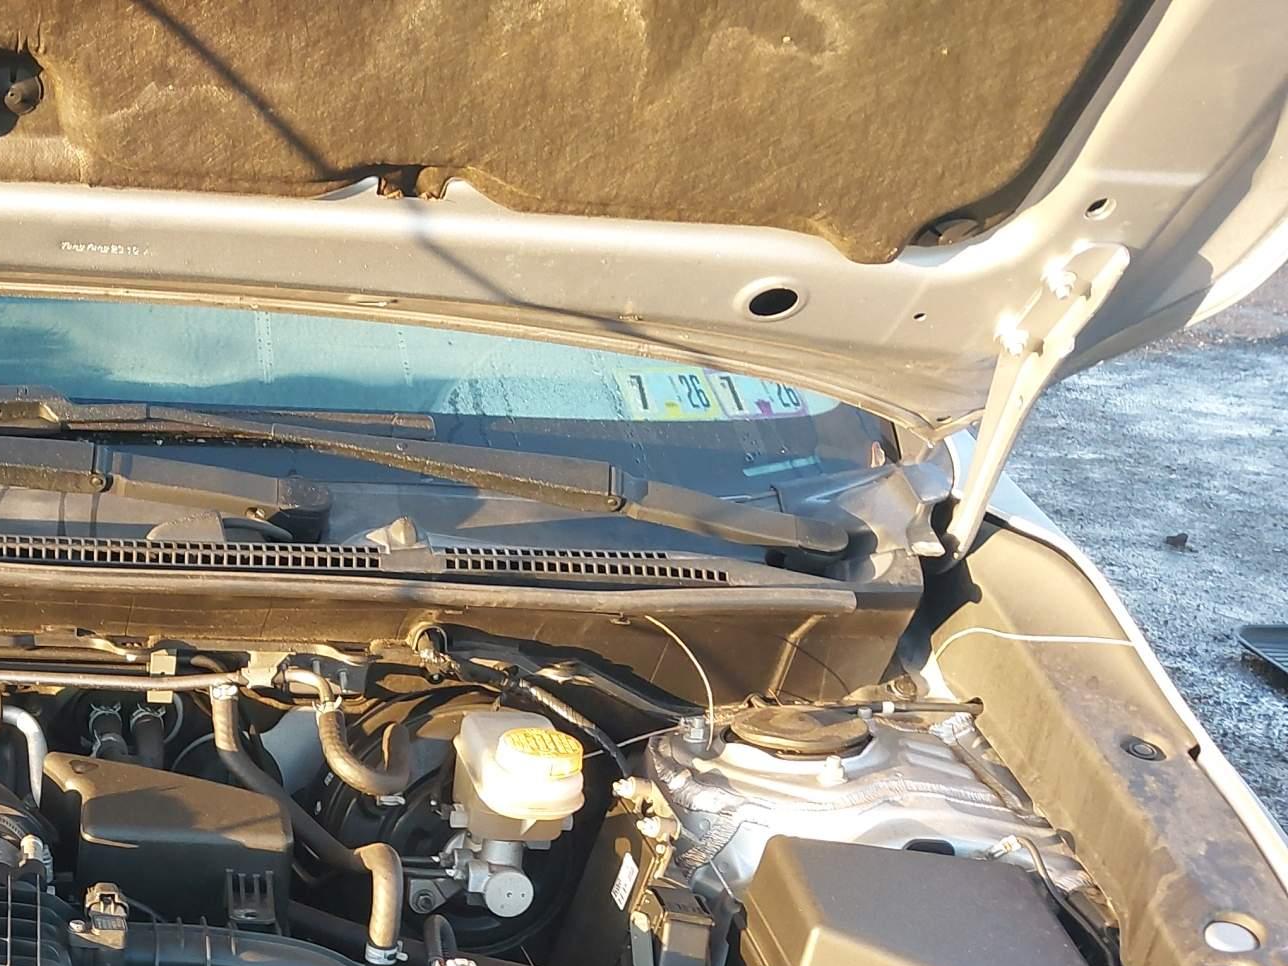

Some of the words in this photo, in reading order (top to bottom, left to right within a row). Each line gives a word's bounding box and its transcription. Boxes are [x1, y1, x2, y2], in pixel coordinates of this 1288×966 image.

[628, 374, 650, 410] 7
[678, 374, 711, 409] 26
[719, 375, 744, 411] 7
